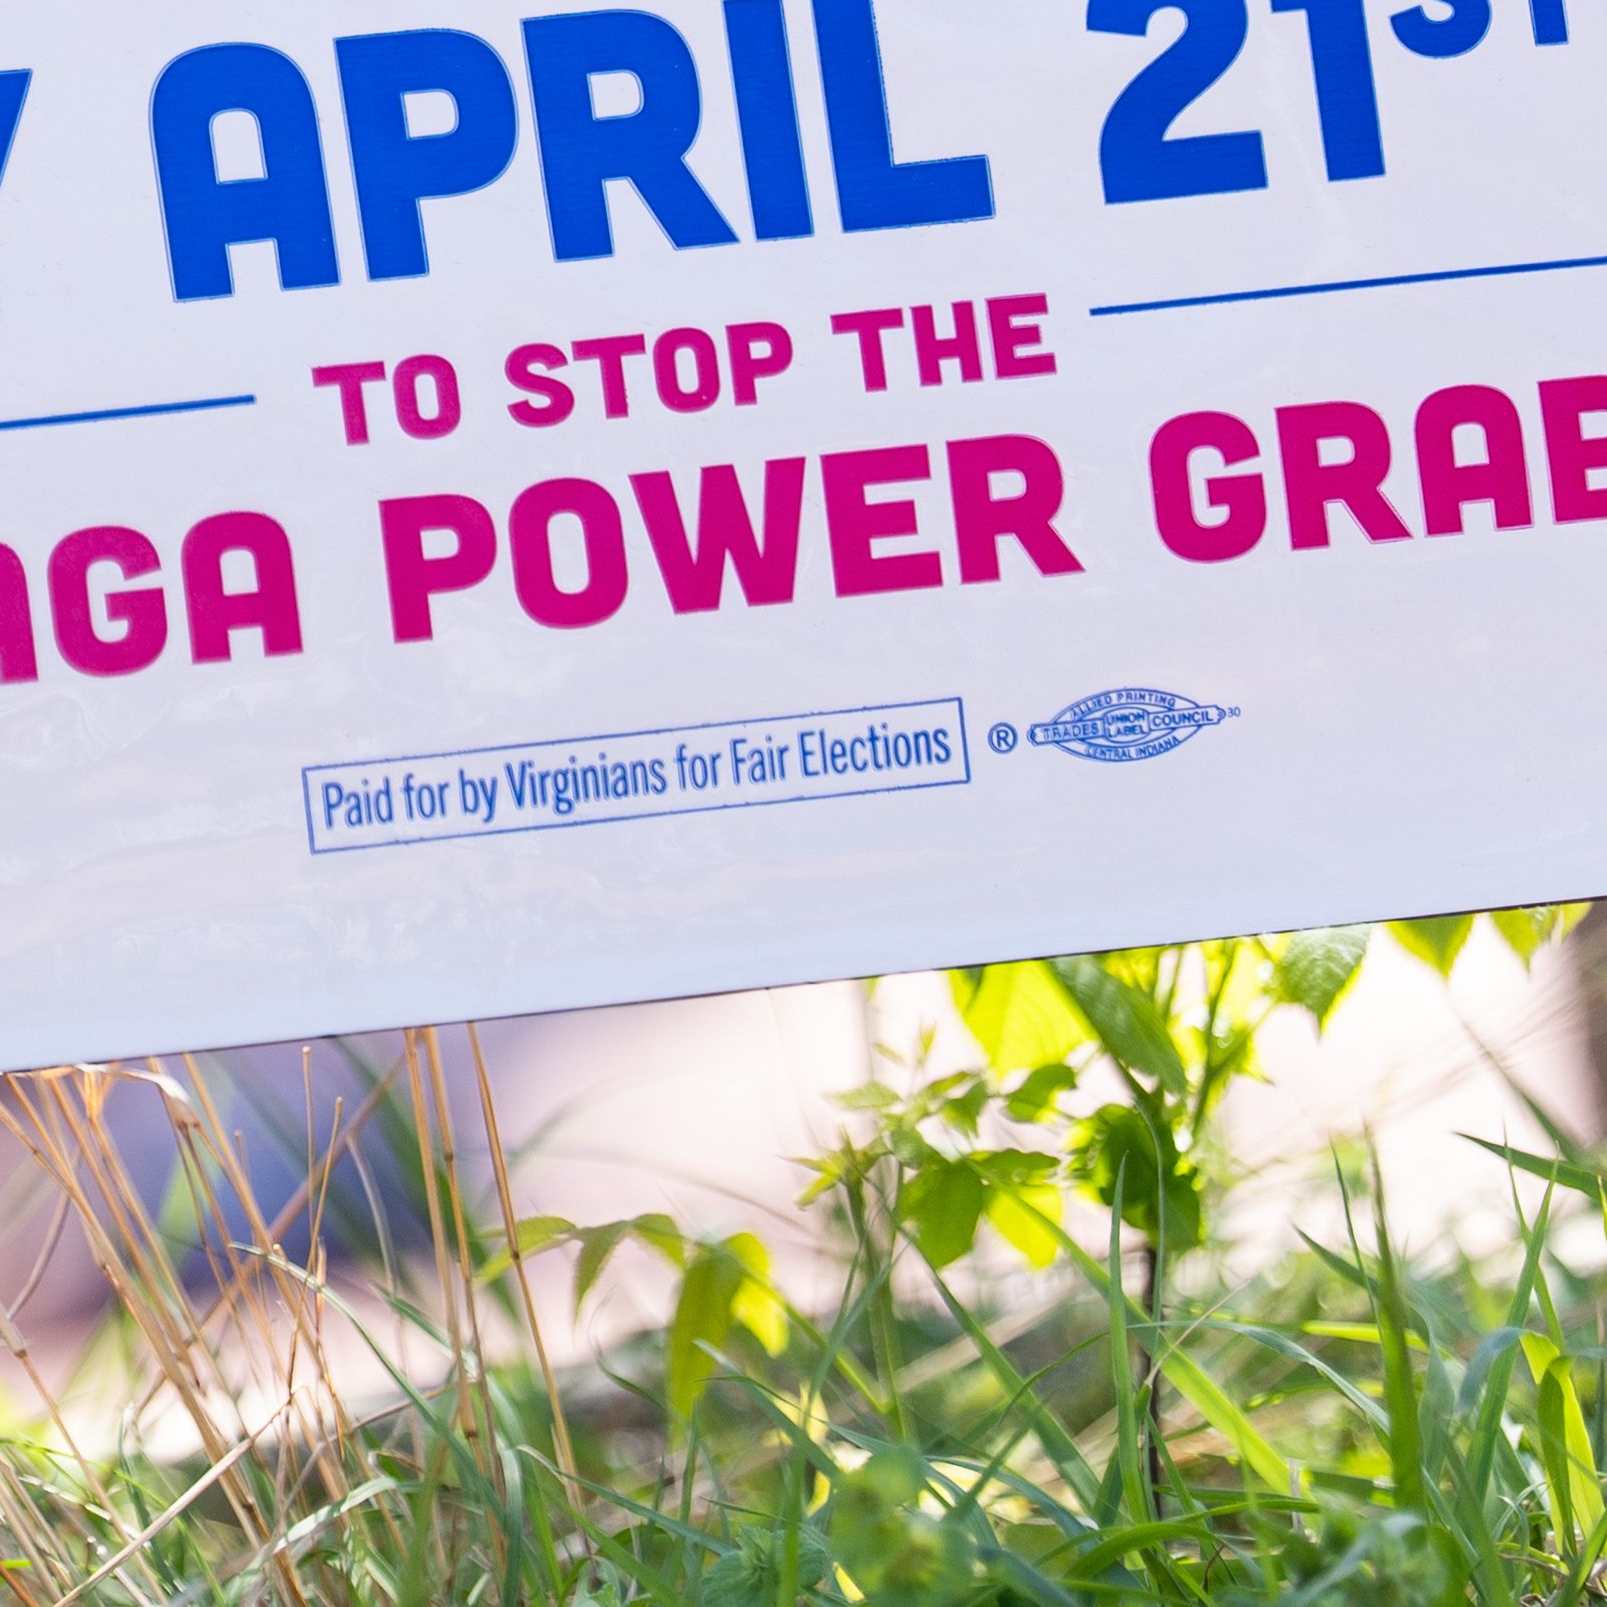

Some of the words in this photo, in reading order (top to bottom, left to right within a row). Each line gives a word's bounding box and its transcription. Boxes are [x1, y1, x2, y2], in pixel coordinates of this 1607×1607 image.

[311, 353, 462, 446] TO
[504, 326, 794, 429] STOP
[829, 292, 1058, 393] THE
[378, 433, 1085, 644] POWER
[1070, 693, 1113, 720] ALLIED
[1116, 689, 1178, 709] PRINTING
[1105, 710, 1147, 725] UNION
[1226, 706, 1242, 718] 30
[1042, 719, 1101, 741] TRADES
[1152, 707, 1215, 728] COUNCIL
[1106, 723, 1147, 738] LABEL
[1085, 744, 1133, 760] CENTRAL
[1135, 734, 1182, 758] INDIANA
[321, 771, 395, 830] Paid
[399, 773, 450, 820] for
[457, 768, 498, 825] by
[504, 751, 668, 817] Virginians
[674, 743, 723, 791] for
[729, 735, 791, 786] Fair
[797, 723, 953, 779] Elections
